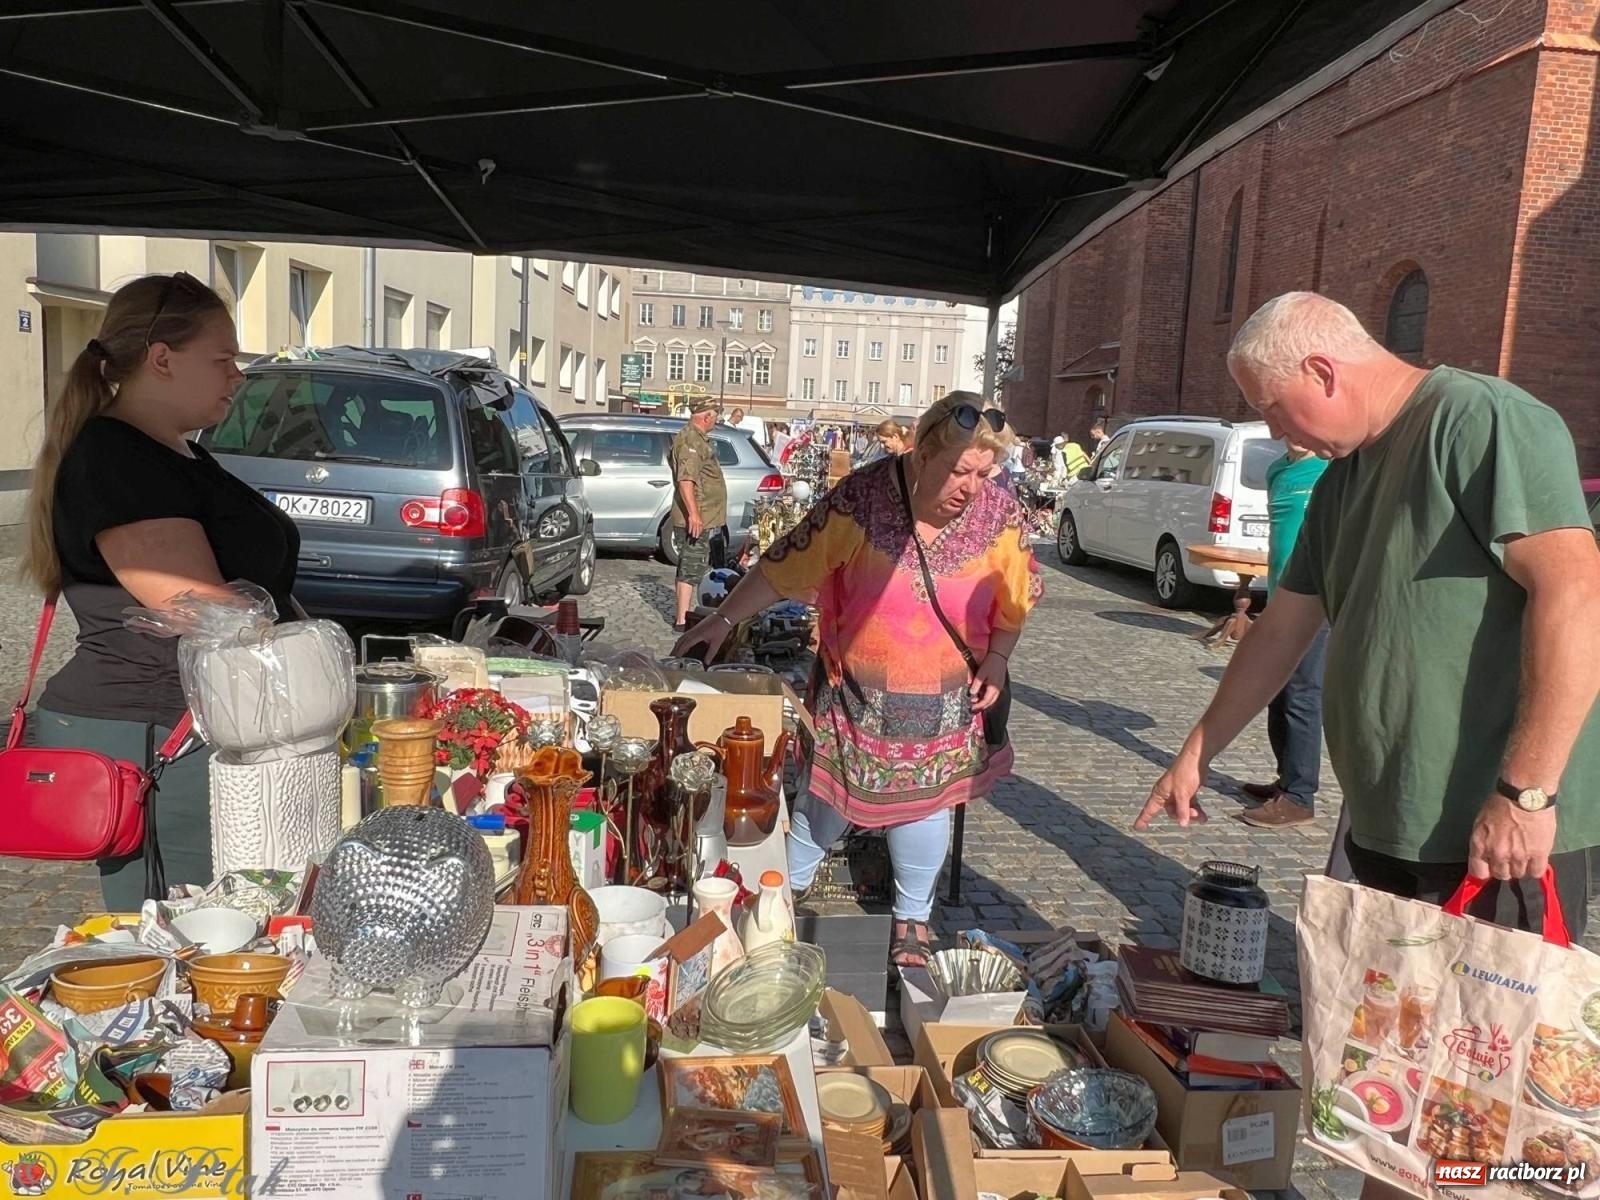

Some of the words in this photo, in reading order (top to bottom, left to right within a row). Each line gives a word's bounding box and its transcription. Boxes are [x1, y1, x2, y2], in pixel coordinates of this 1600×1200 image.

[22, 317, 29, 327] 2
[279, 496, 303, 514] OK
[309, 498, 363, 518] 78022
[1472, 968, 1537, 995] LEWIATAN
[66, 1150, 161, 1192] Royal
[165, 1156, 226, 1178] Vine
